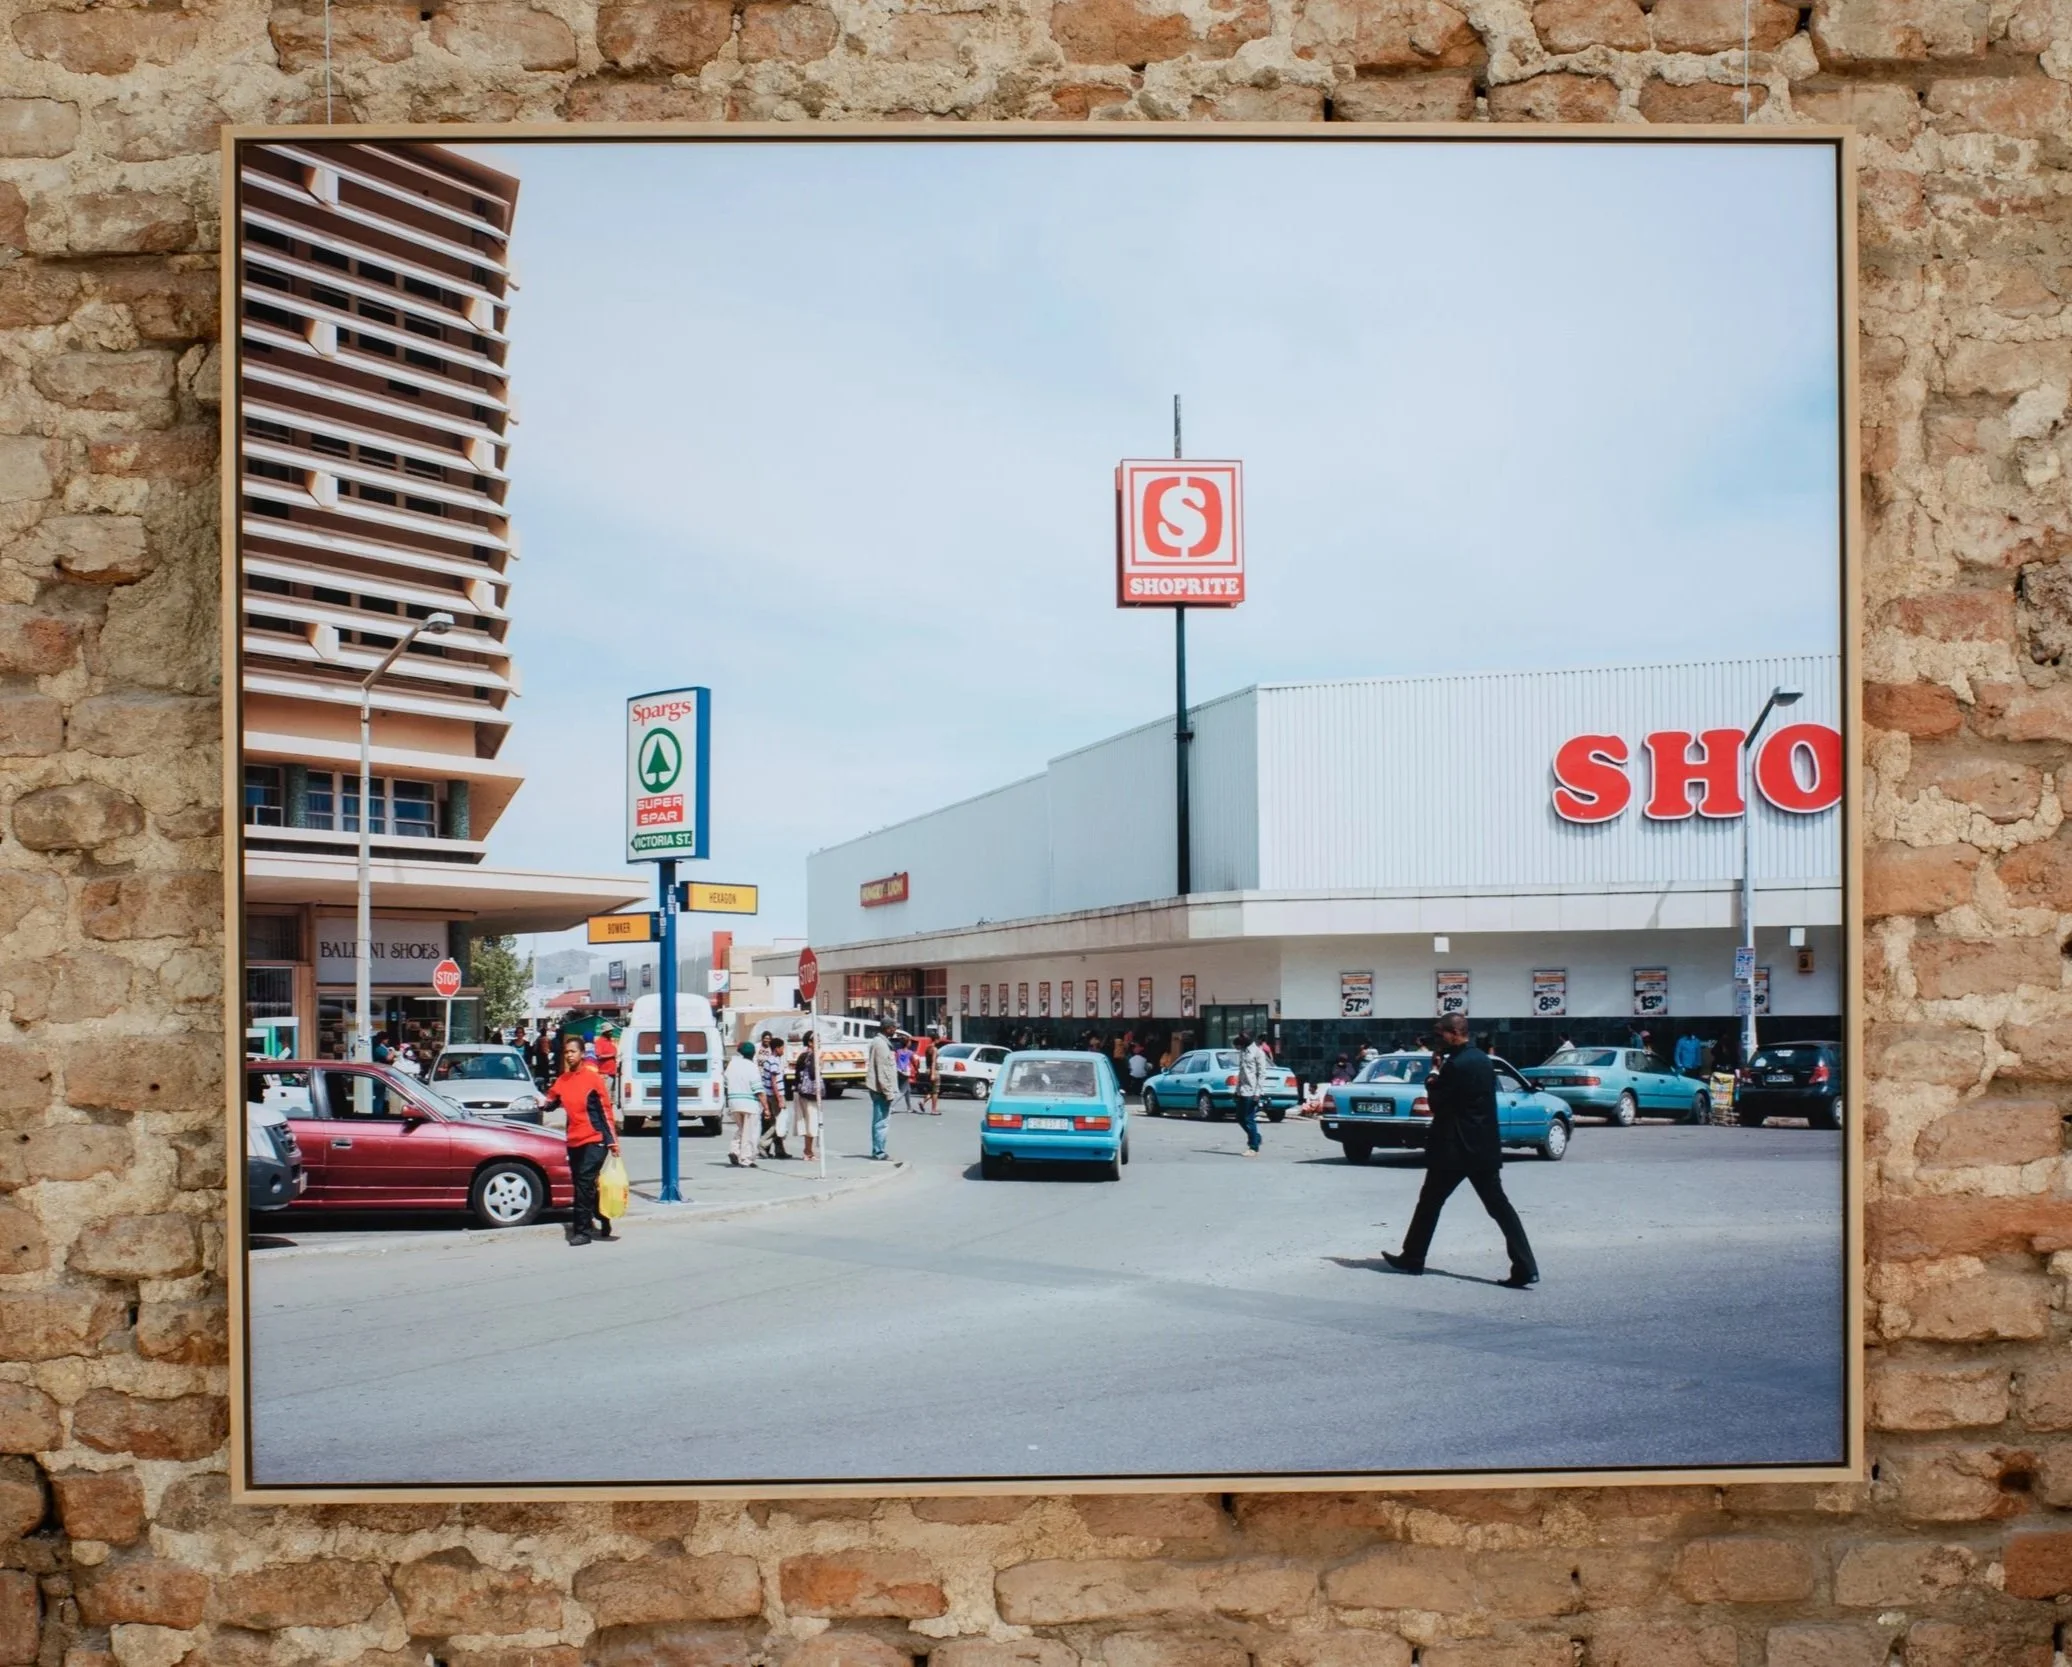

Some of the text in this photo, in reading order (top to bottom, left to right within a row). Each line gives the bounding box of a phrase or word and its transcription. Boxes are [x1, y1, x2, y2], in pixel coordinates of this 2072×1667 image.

[1130, 578, 1240, 596] SHOPRITE
[632, 701, 691, 725] Spargs
[1552, 722, 1842, 824] SHO
[636, 795, 683, 811] SUPER
[640, 809, 678, 824] SPAR
[634, 833, 691, 849] VICTORIA ST.
[709, 892, 737, 905] HEXAGON
[320, 942, 440, 960] BALNI SHOES
[436, 971, 460, 985] STOP
[800, 961, 816, 986] STOP
